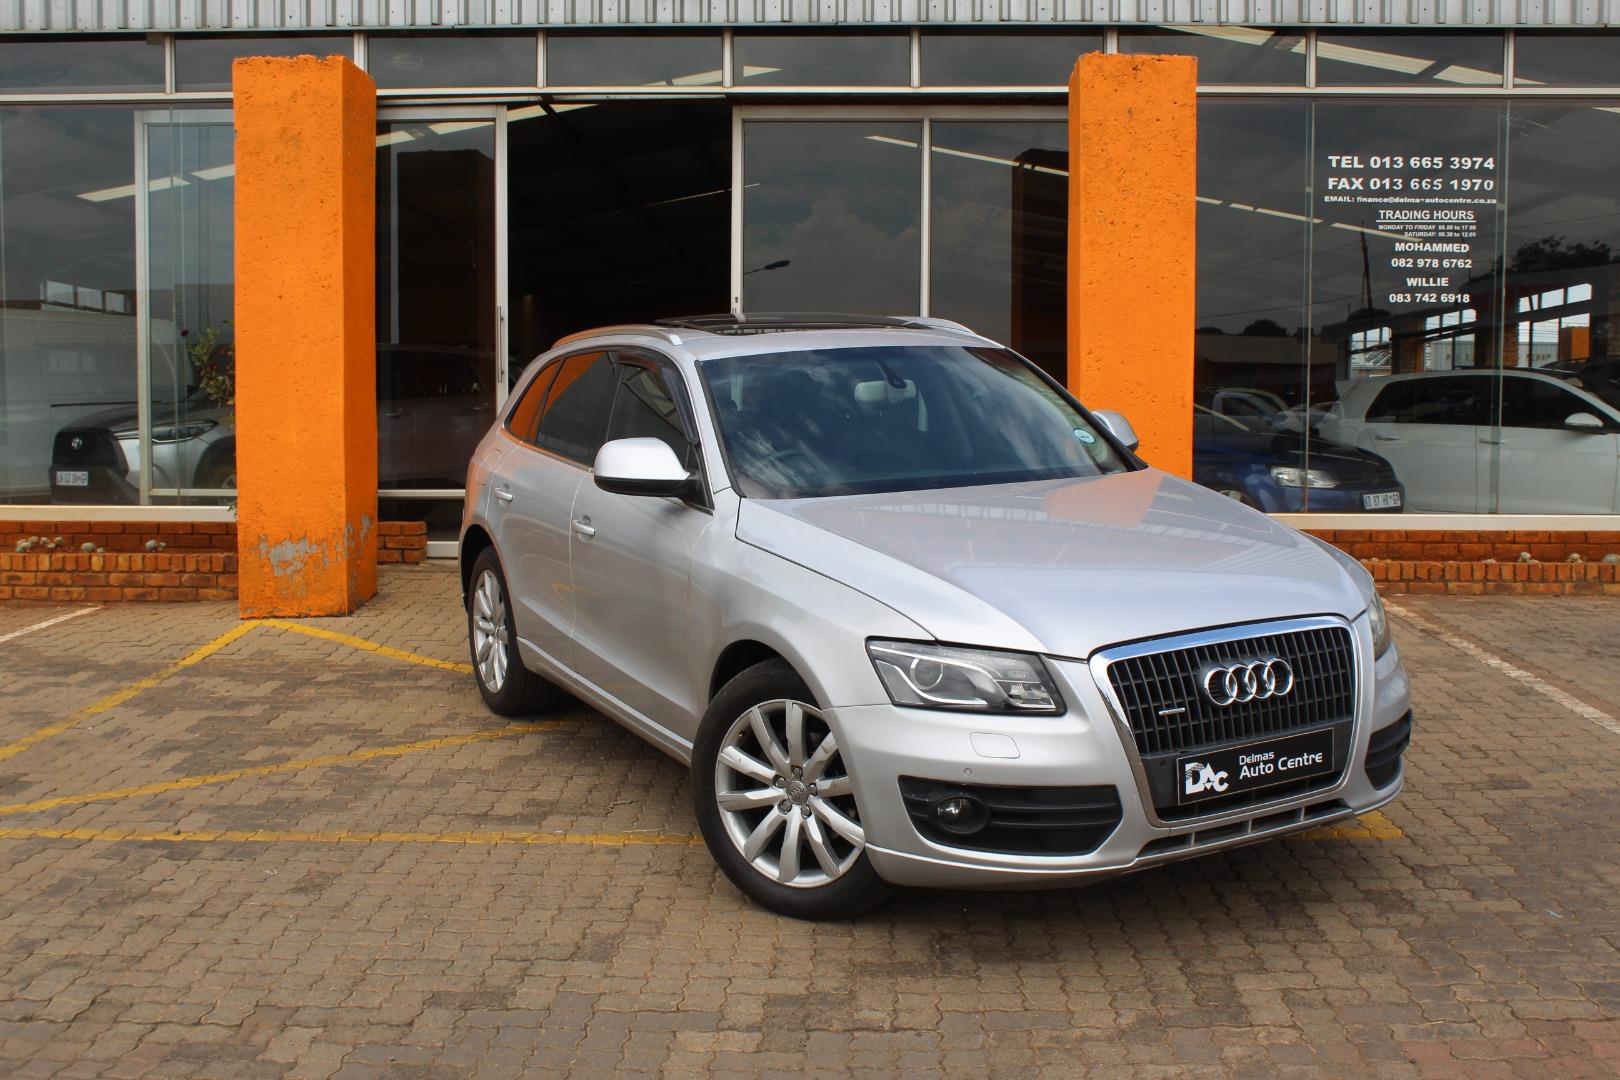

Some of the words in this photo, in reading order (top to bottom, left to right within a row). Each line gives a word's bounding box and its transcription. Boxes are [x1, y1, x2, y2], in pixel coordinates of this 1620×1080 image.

[1328, 156, 1364, 169] TEL
[1370, 156, 1403, 169] 013
[1410, 156, 1443, 169] 665
[1449, 157, 1495, 170] 3974
[1328, 177, 1364, 190] FAX
[1370, 178, 1403, 190] 013
[1410, 178, 1443, 191] 665
[1449, 178, 1494, 191] 1970
[1324, 195, 1355, 203] EMAIL:
[1378, 210, 1430, 220] TRADING
[1433, 210, 1474, 220] HOURS
[1395, 242, 1470, 253] MOHAMMED
[1391, 258, 1413, 267] 082
[1417, 258, 1439, 268] 978
[1442, 259, 1472, 268] 6762
[1406, 277, 1449, 287] WILLIE
[1389, 293, 1411, 303] 083
[1415, 293, 1437, 303] 742
[1440, 293, 1470, 303] 6918
[1238, 751, 1275, 766] Delmas
[1239, 762, 1274, 780] Auto
[1277, 752, 1323, 771] Centre
